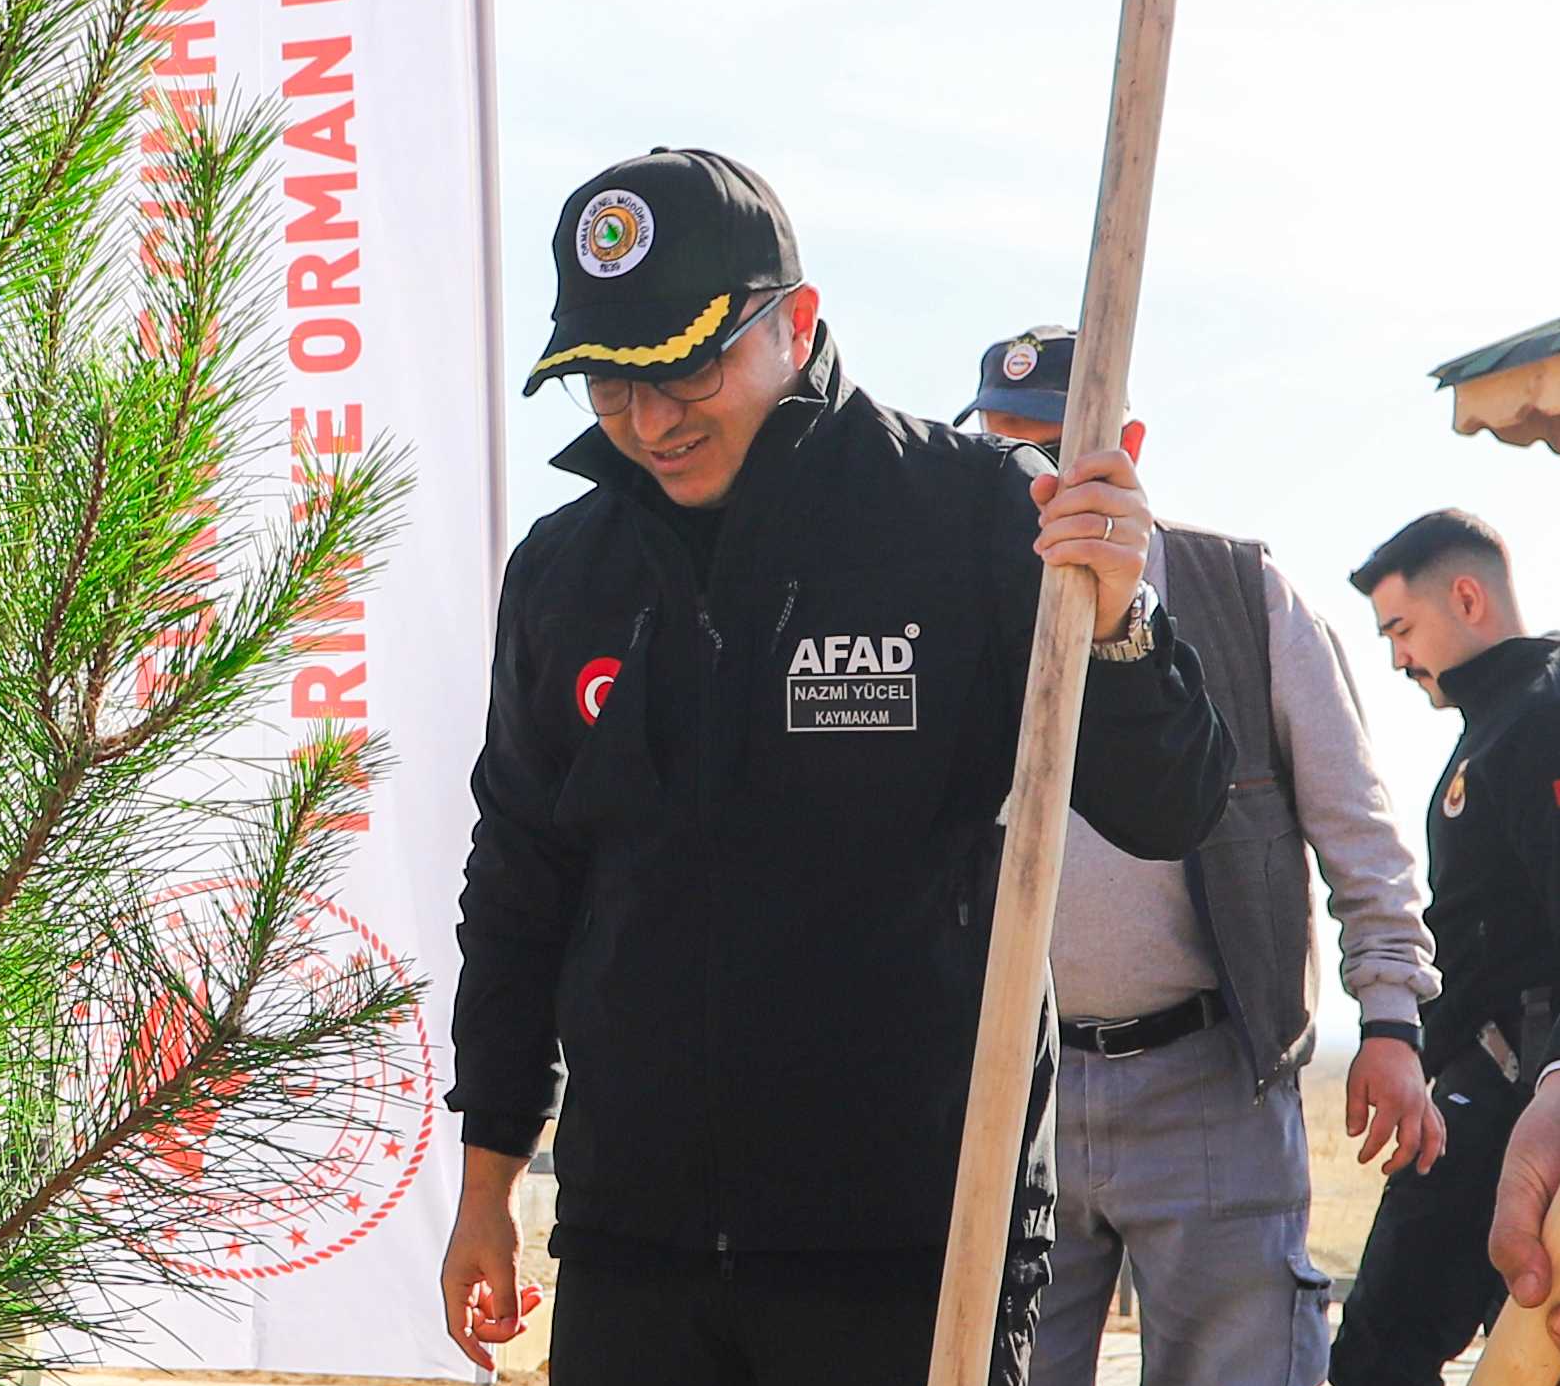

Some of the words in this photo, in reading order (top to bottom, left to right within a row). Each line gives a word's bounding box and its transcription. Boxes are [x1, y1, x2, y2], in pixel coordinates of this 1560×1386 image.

[281, 34, 363, 374] ORMAN
[788, 635, 914, 675] AFAD
[794, 683, 848, 701] NAZMİ
[851, 683, 910, 700] YÜCEL
[815, 710, 890, 725] KAYMAKAM
